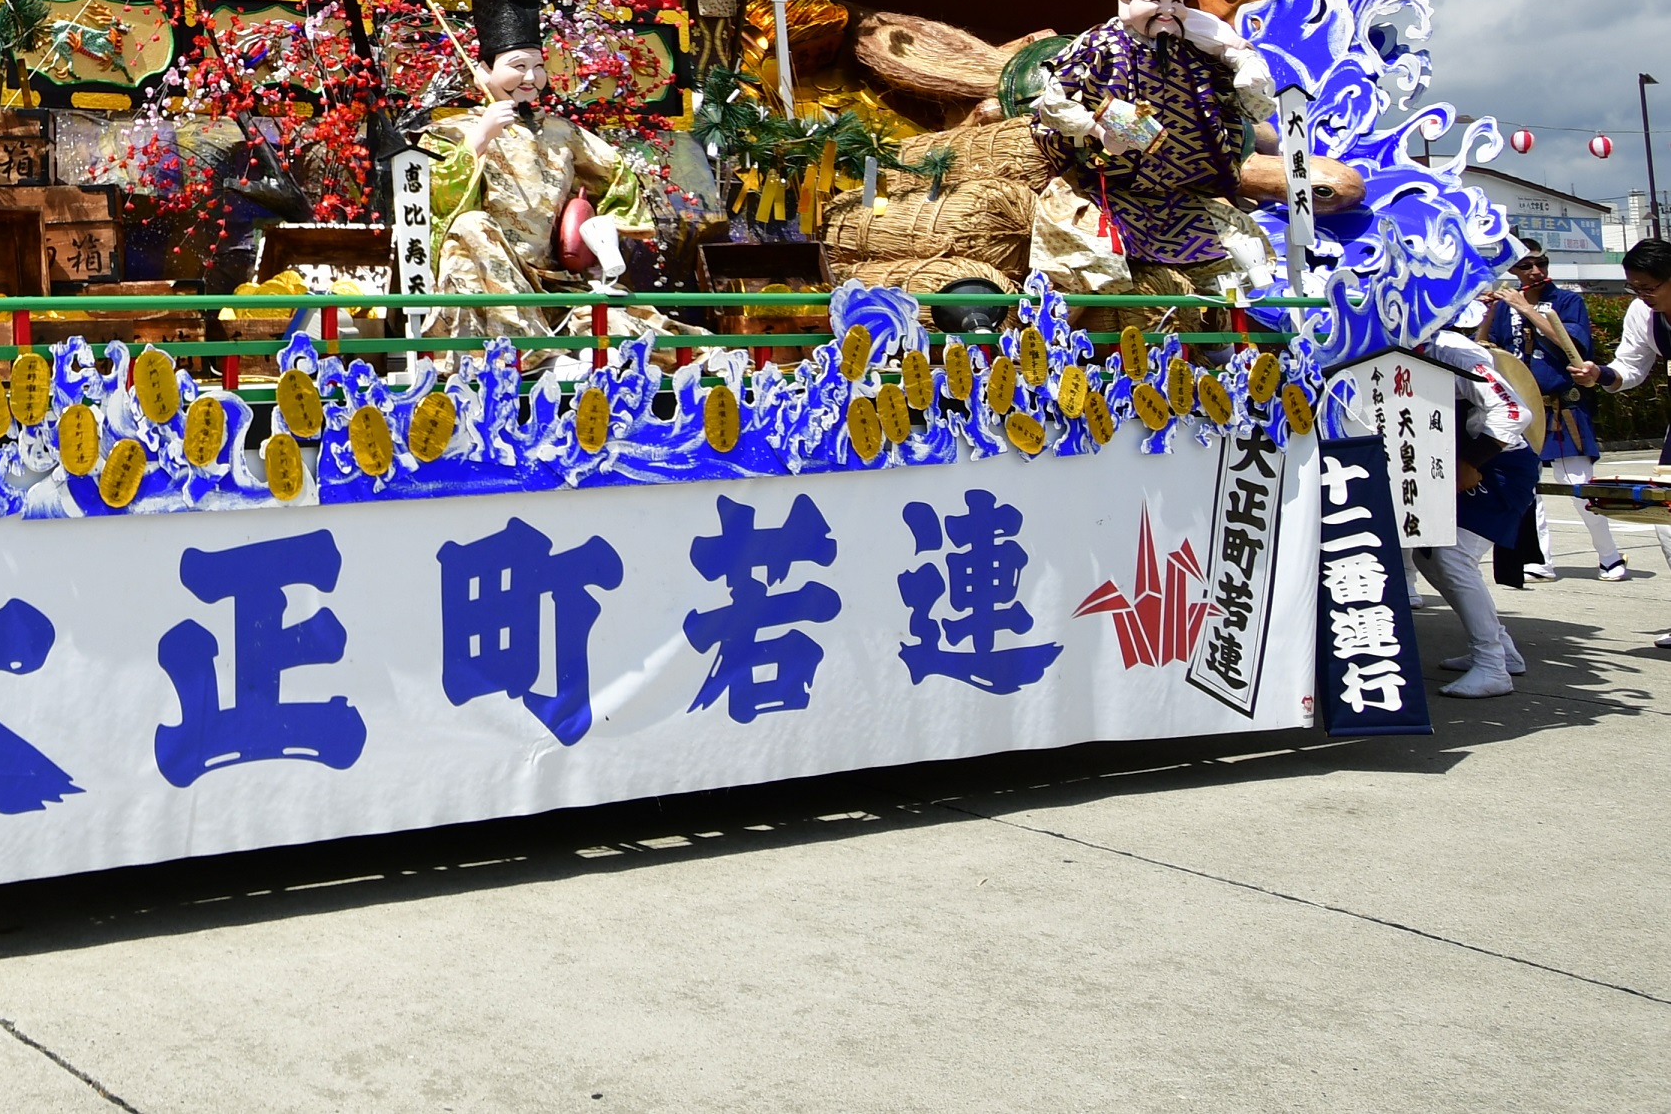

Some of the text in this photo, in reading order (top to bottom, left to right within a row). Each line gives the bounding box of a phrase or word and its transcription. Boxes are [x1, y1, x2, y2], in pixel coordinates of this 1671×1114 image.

[403, 161, 428, 295] 恵比寿天
[1287, 110, 1311, 216] 大黒天
[1206, 422, 1277, 690] 大正町若連
[1320, 456, 1407, 713] 十二番運行
